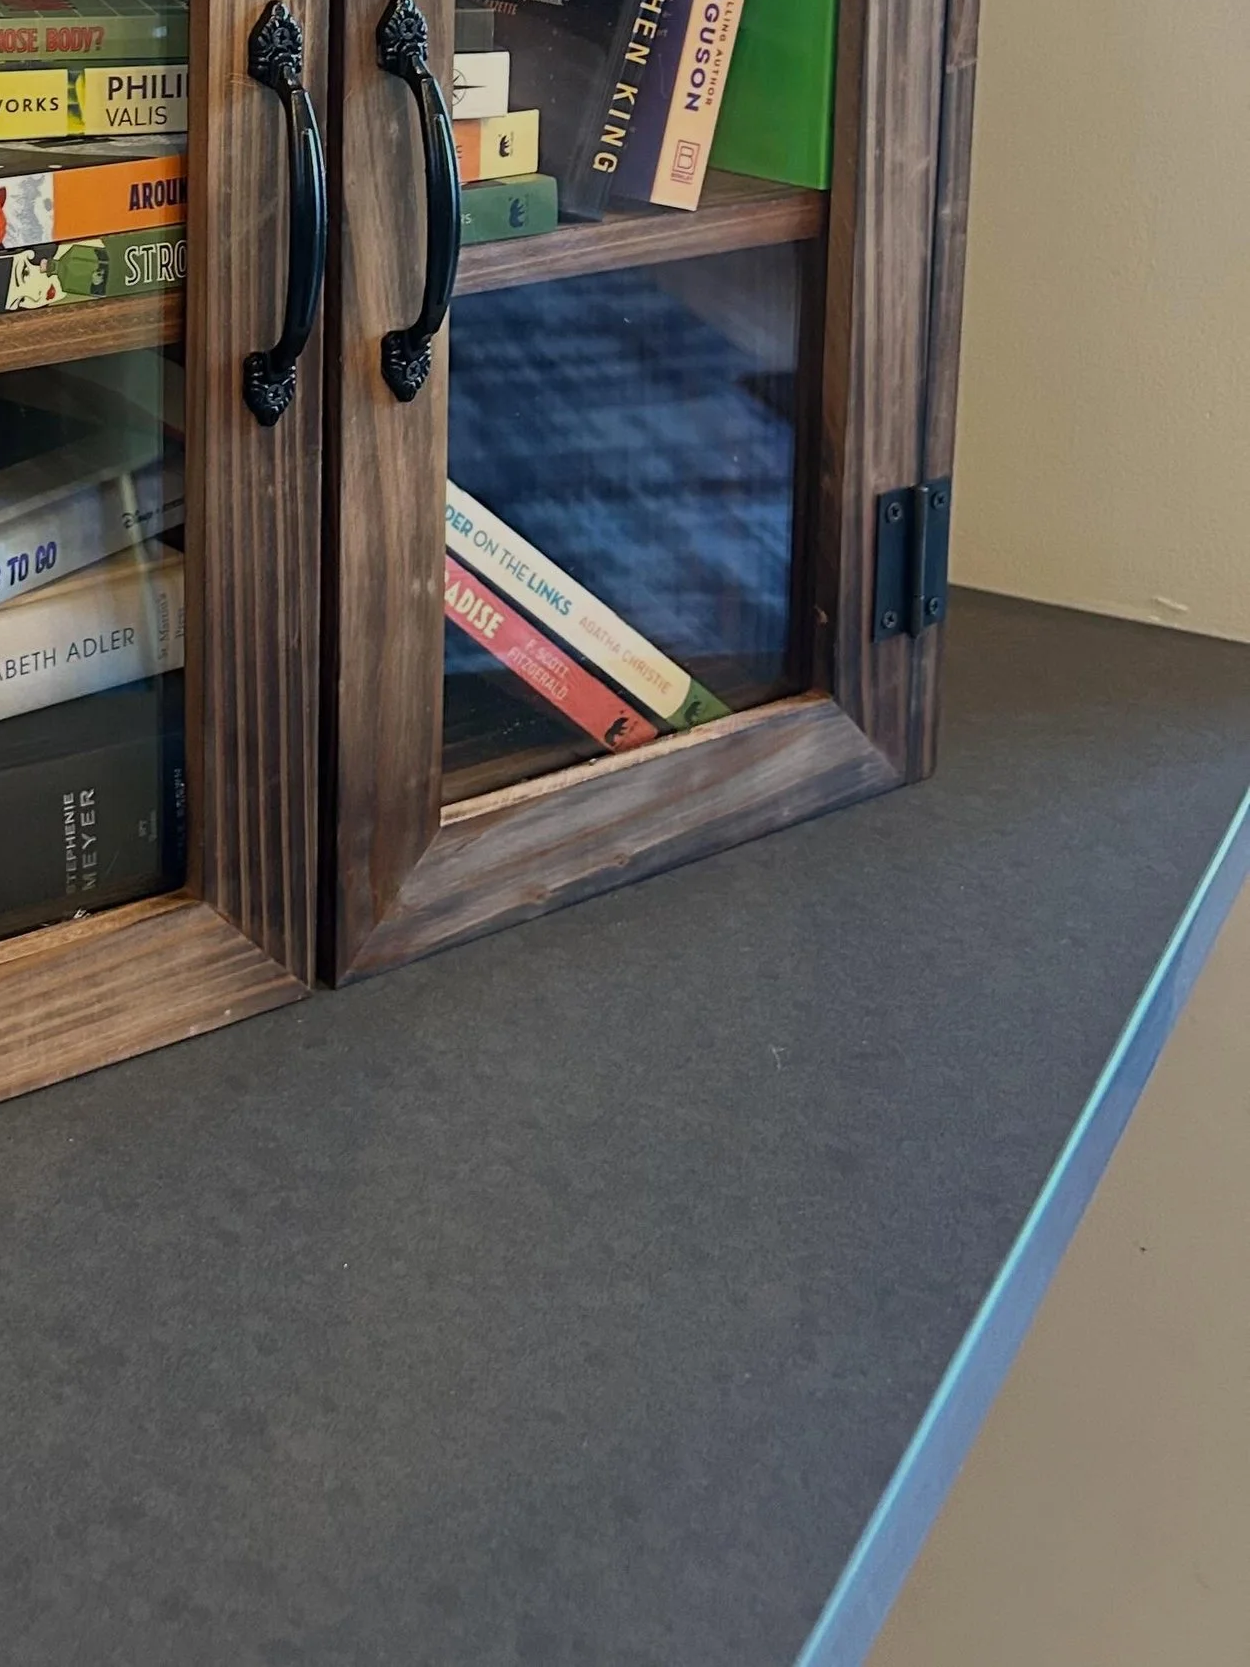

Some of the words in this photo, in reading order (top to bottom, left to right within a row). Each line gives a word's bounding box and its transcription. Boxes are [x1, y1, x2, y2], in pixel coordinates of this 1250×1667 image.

[45, 26, 106, 54] BODY?
[107, 72, 188, 101] PHILI
[704, 48, 724, 107] AUTHOR
[105, 105, 168, 127] VALIS
[591, 81, 639, 175] KING
[6, 552, 30, 586] TO
[35, 541, 58, 575] GO
[473, 529, 500, 557] ON
[499, 548, 530, 584] THE
[526, 572, 573, 617] LINKS
[445, 570, 506, 640] ADISE
[65, 626, 136, 664] ADLER
[506, 645, 571, 702] FITZGERALD
[536, 645, 571, 679] SCOTT
[578, 615, 621, 658] AGATHA
[621, 649, 673, 696] CHRISTIE
[79, 786, 99, 893] MEYER
